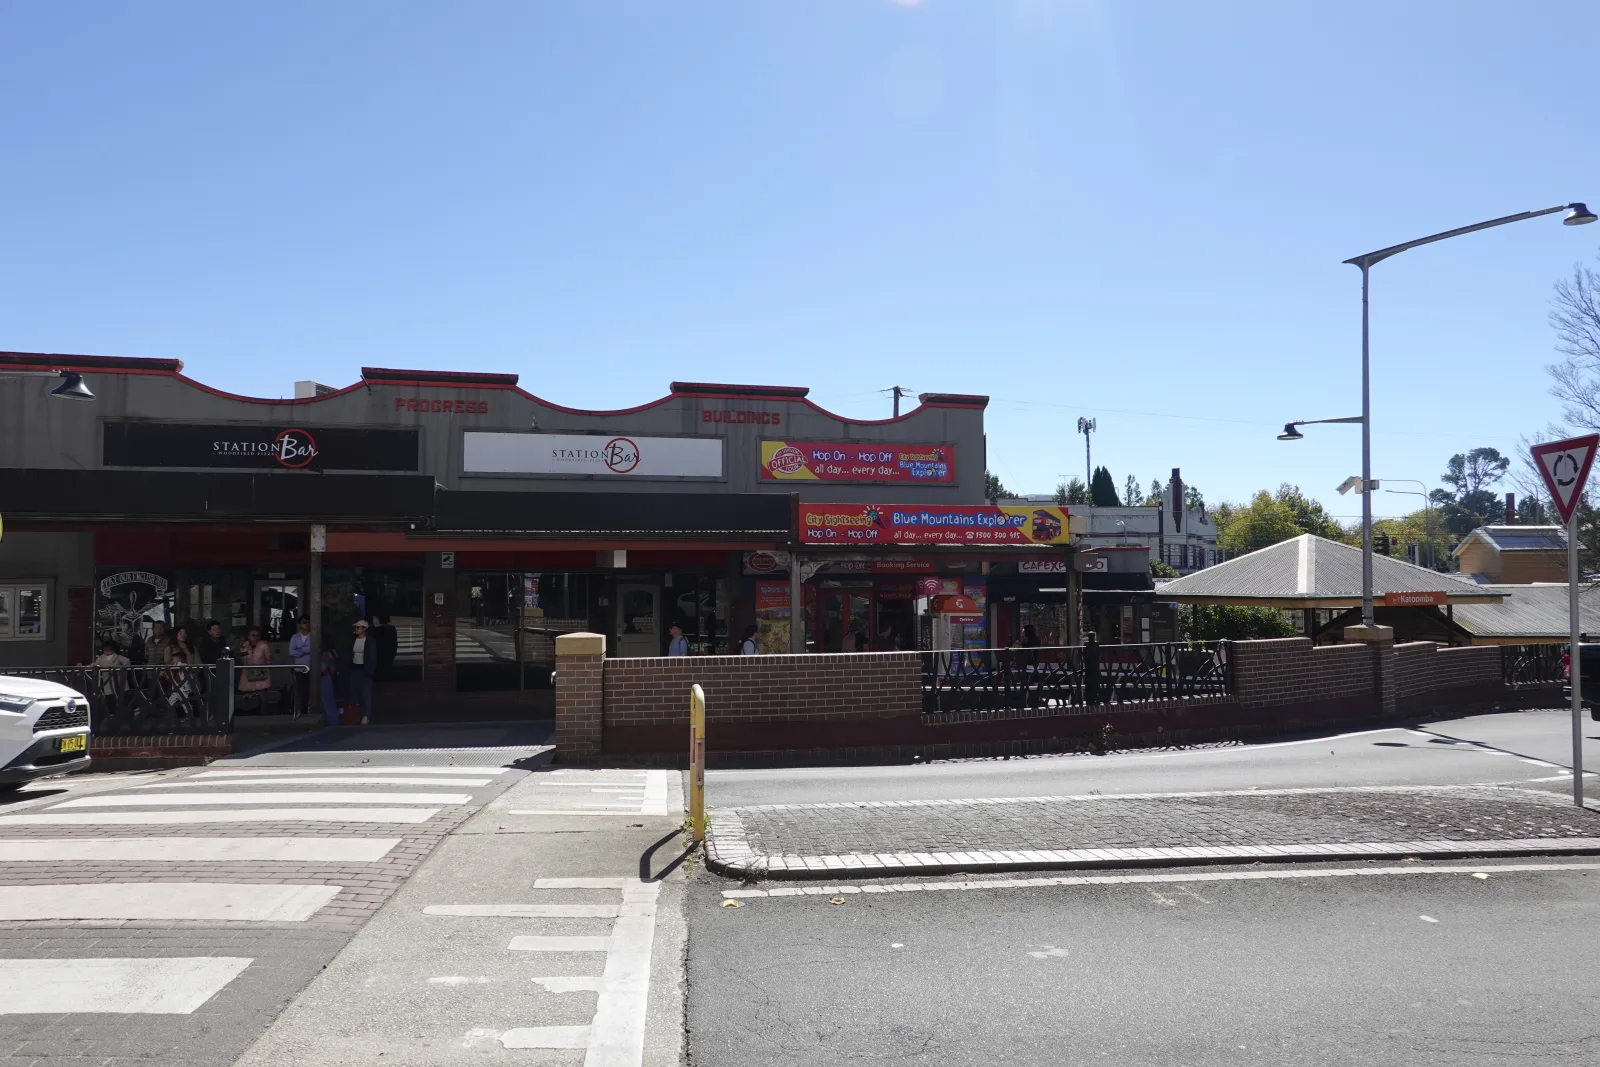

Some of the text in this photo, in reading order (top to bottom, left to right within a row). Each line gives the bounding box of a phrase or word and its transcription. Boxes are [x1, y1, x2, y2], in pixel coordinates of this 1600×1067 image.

[395, 397, 488, 414] PROGRESS
[702, 410, 780, 425] BUILDINGS
[213, 434, 318, 460] STATION Bar
[552, 443, 642, 467] STATION Bar
[812, 450, 831, 462] Hop
[833, 450, 846, 461] On
[858, 452, 876, 463] Hop
[878, 452, 893, 462] Off
[771, 456, 806, 469] OFFICIAL
[899, 461, 947, 470] Blue Mountains
[814, 464, 900, 476] all day... every day...
[912, 468, 947, 477] Explorer
[806, 513, 873, 527] City Sightseeing
[893, 512, 1025, 528] Blue Mountains Explorer
[807, 529, 823, 539] Hop
[825, 528, 837, 538] On
[848, 529, 863, 539] Hop
[865, 529, 878, 539] Off
[894, 531, 902, 539] all
[904, 531, 922, 540] day...
[924, 532, 943, 540] every
[945, 531, 963, 540] day...
[975, 532, 991, 540] 1300
[994, 532, 1007, 540] 300
[840, 562, 865, 570] Hop Off
[103, 576, 118, 587] TRY
[119, 573, 132, 583] OUR
[1400, 595, 1434, 603] Katoomba
